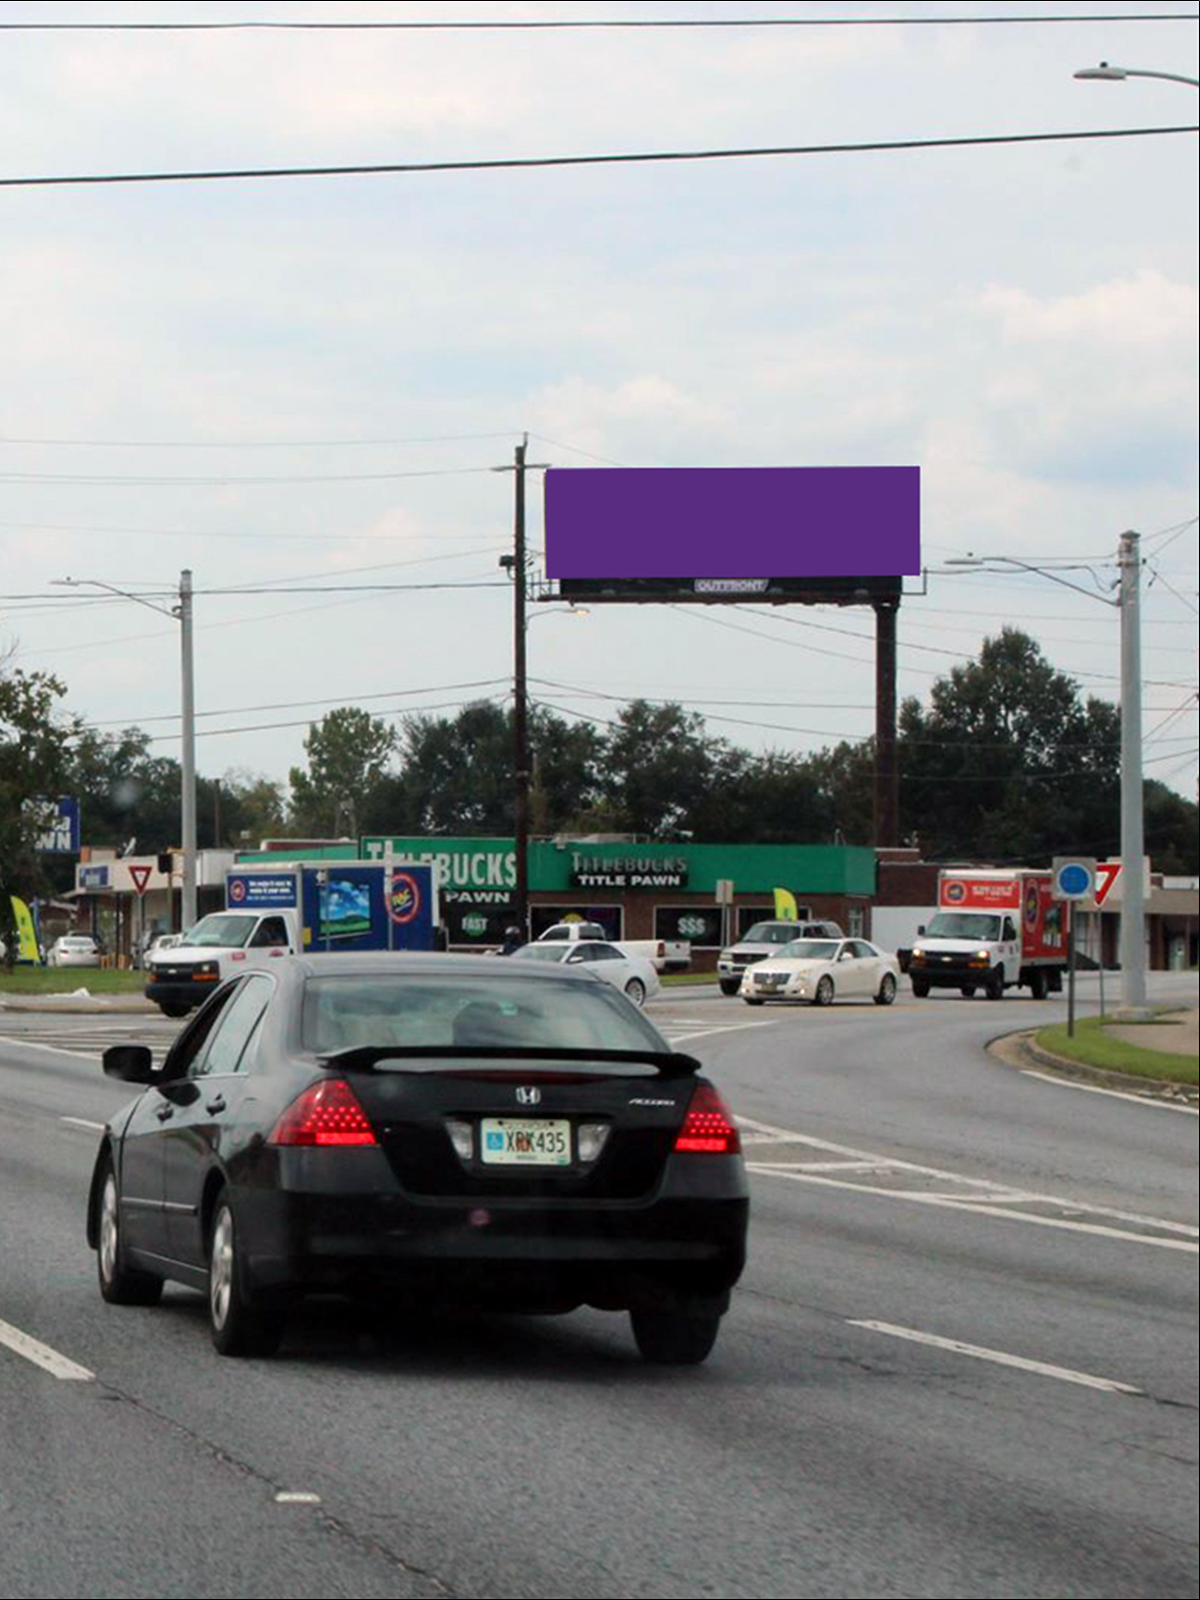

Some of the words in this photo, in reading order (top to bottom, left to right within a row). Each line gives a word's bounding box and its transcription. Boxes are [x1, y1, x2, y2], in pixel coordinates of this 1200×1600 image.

[697, 580, 765, 592] OUTFRONT
[578, 875, 626, 886] TITLE
[631, 875, 680, 886] PAWN
[445, 892, 510, 903] PAWN
[461, 917, 488, 930] FAST
